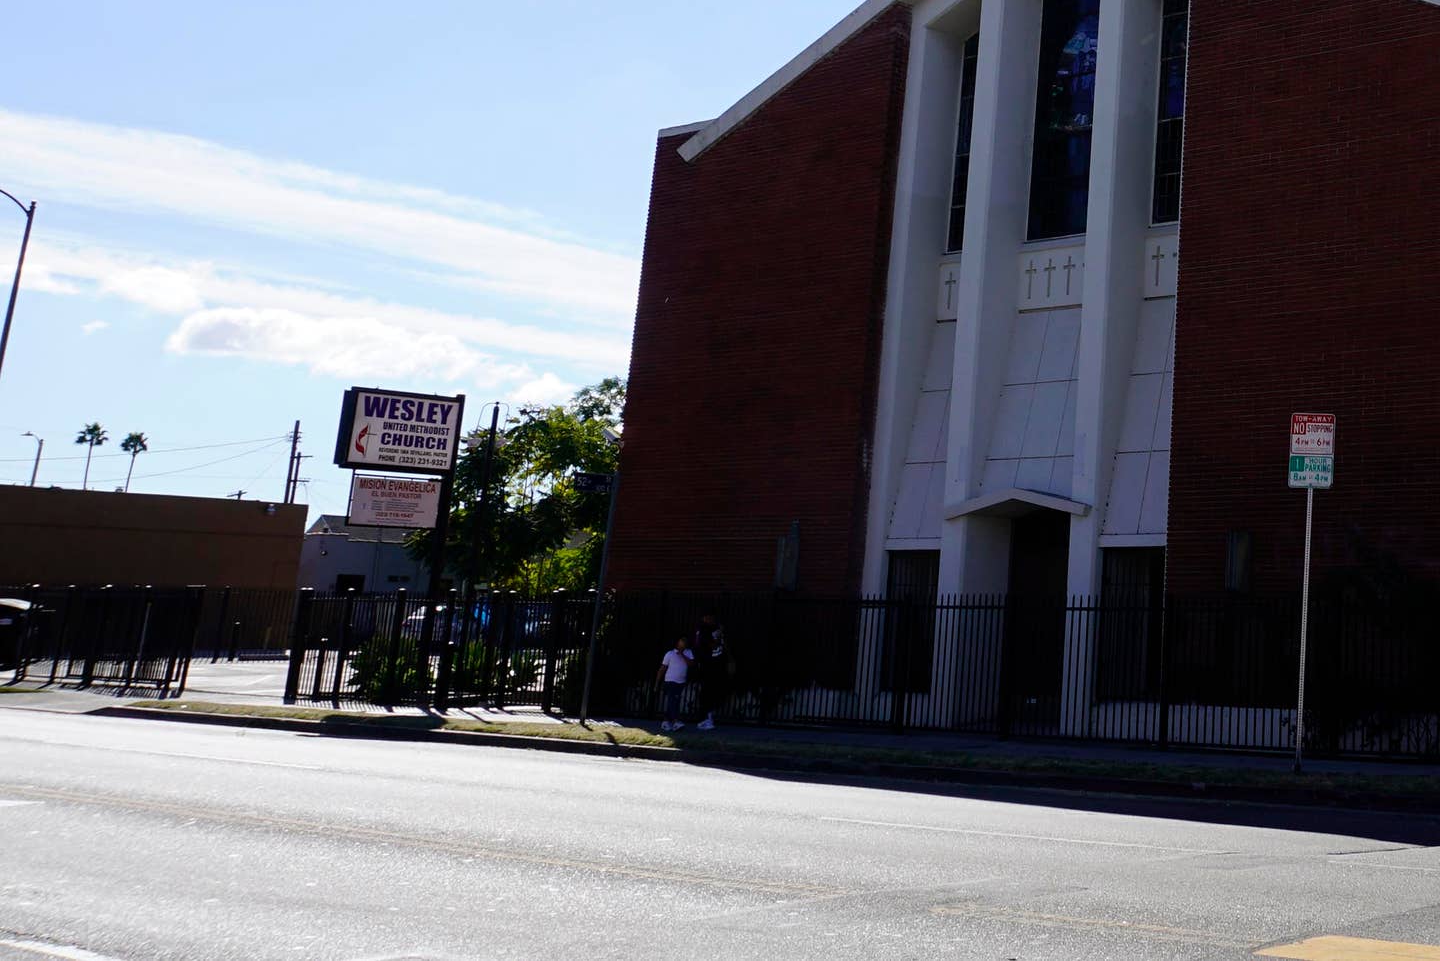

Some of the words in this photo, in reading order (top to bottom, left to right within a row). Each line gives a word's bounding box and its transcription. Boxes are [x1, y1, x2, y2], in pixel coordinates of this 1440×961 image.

[364, 395, 453, 425] WESLEY
[1295, 415, 1332, 423] TOW-AWAY
[383, 421, 408, 432] UNITED
[409, 424, 450, 436] METHODIST
[1293, 423, 1305, 434] NO
[1307, 424, 1333, 433] STOPPING
[381, 432, 448, 450] CHURCH
[378, 454, 396, 463] PHONE
[399, 456, 416, 465] (323)
[1305, 463, 1331, 473] PARKING
[360, 478, 386, 490] MISION
[388, 481, 436, 494] EVANGELICA
